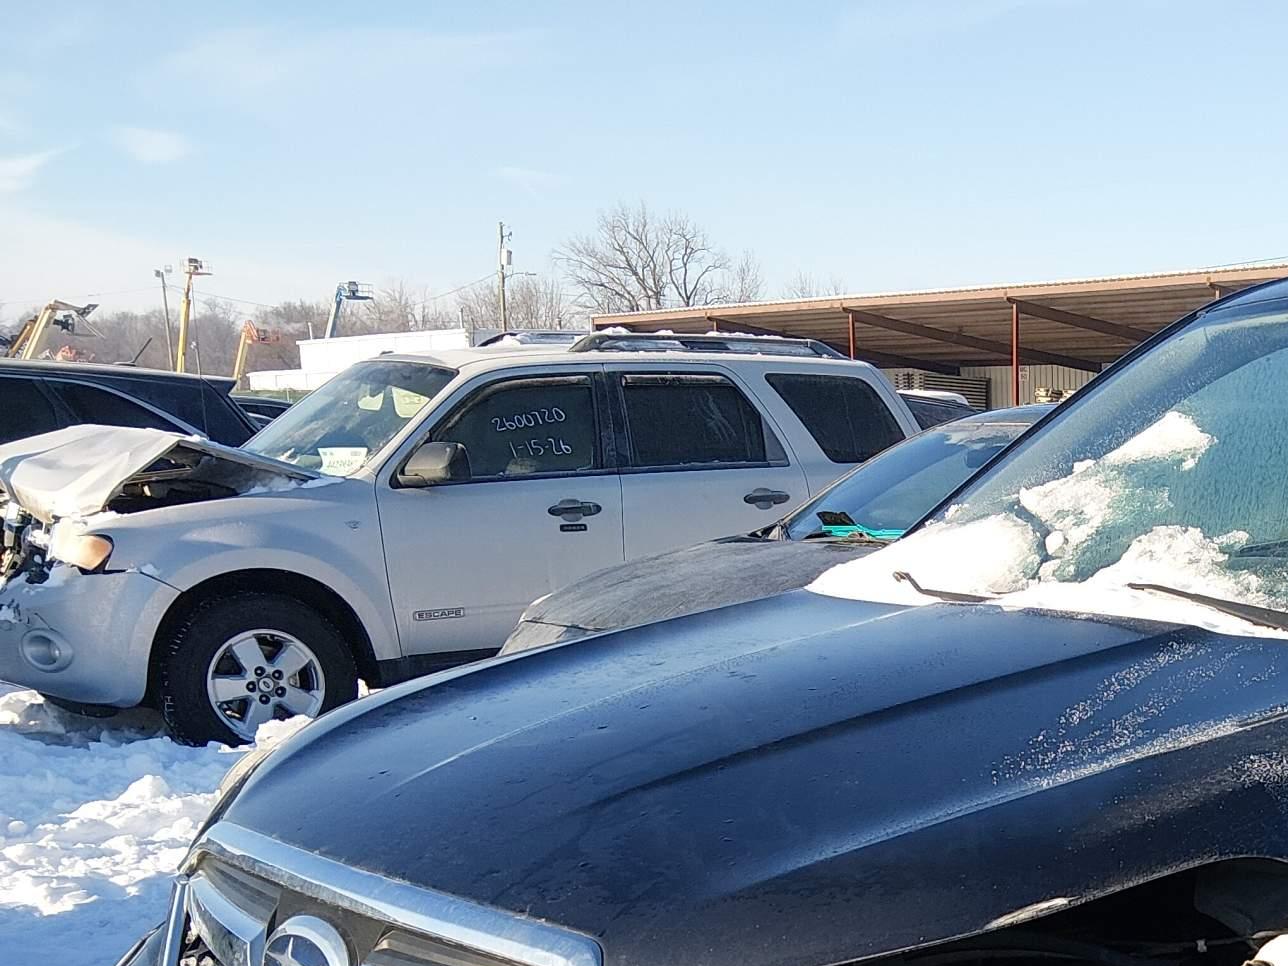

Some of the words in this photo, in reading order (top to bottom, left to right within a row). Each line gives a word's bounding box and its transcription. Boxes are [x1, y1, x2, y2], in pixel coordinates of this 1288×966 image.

[491, 407, 566, 432] 2600720
[509, 438, 572, 459] 1-15-26
[417, 609, 462, 619] ESCAPE
